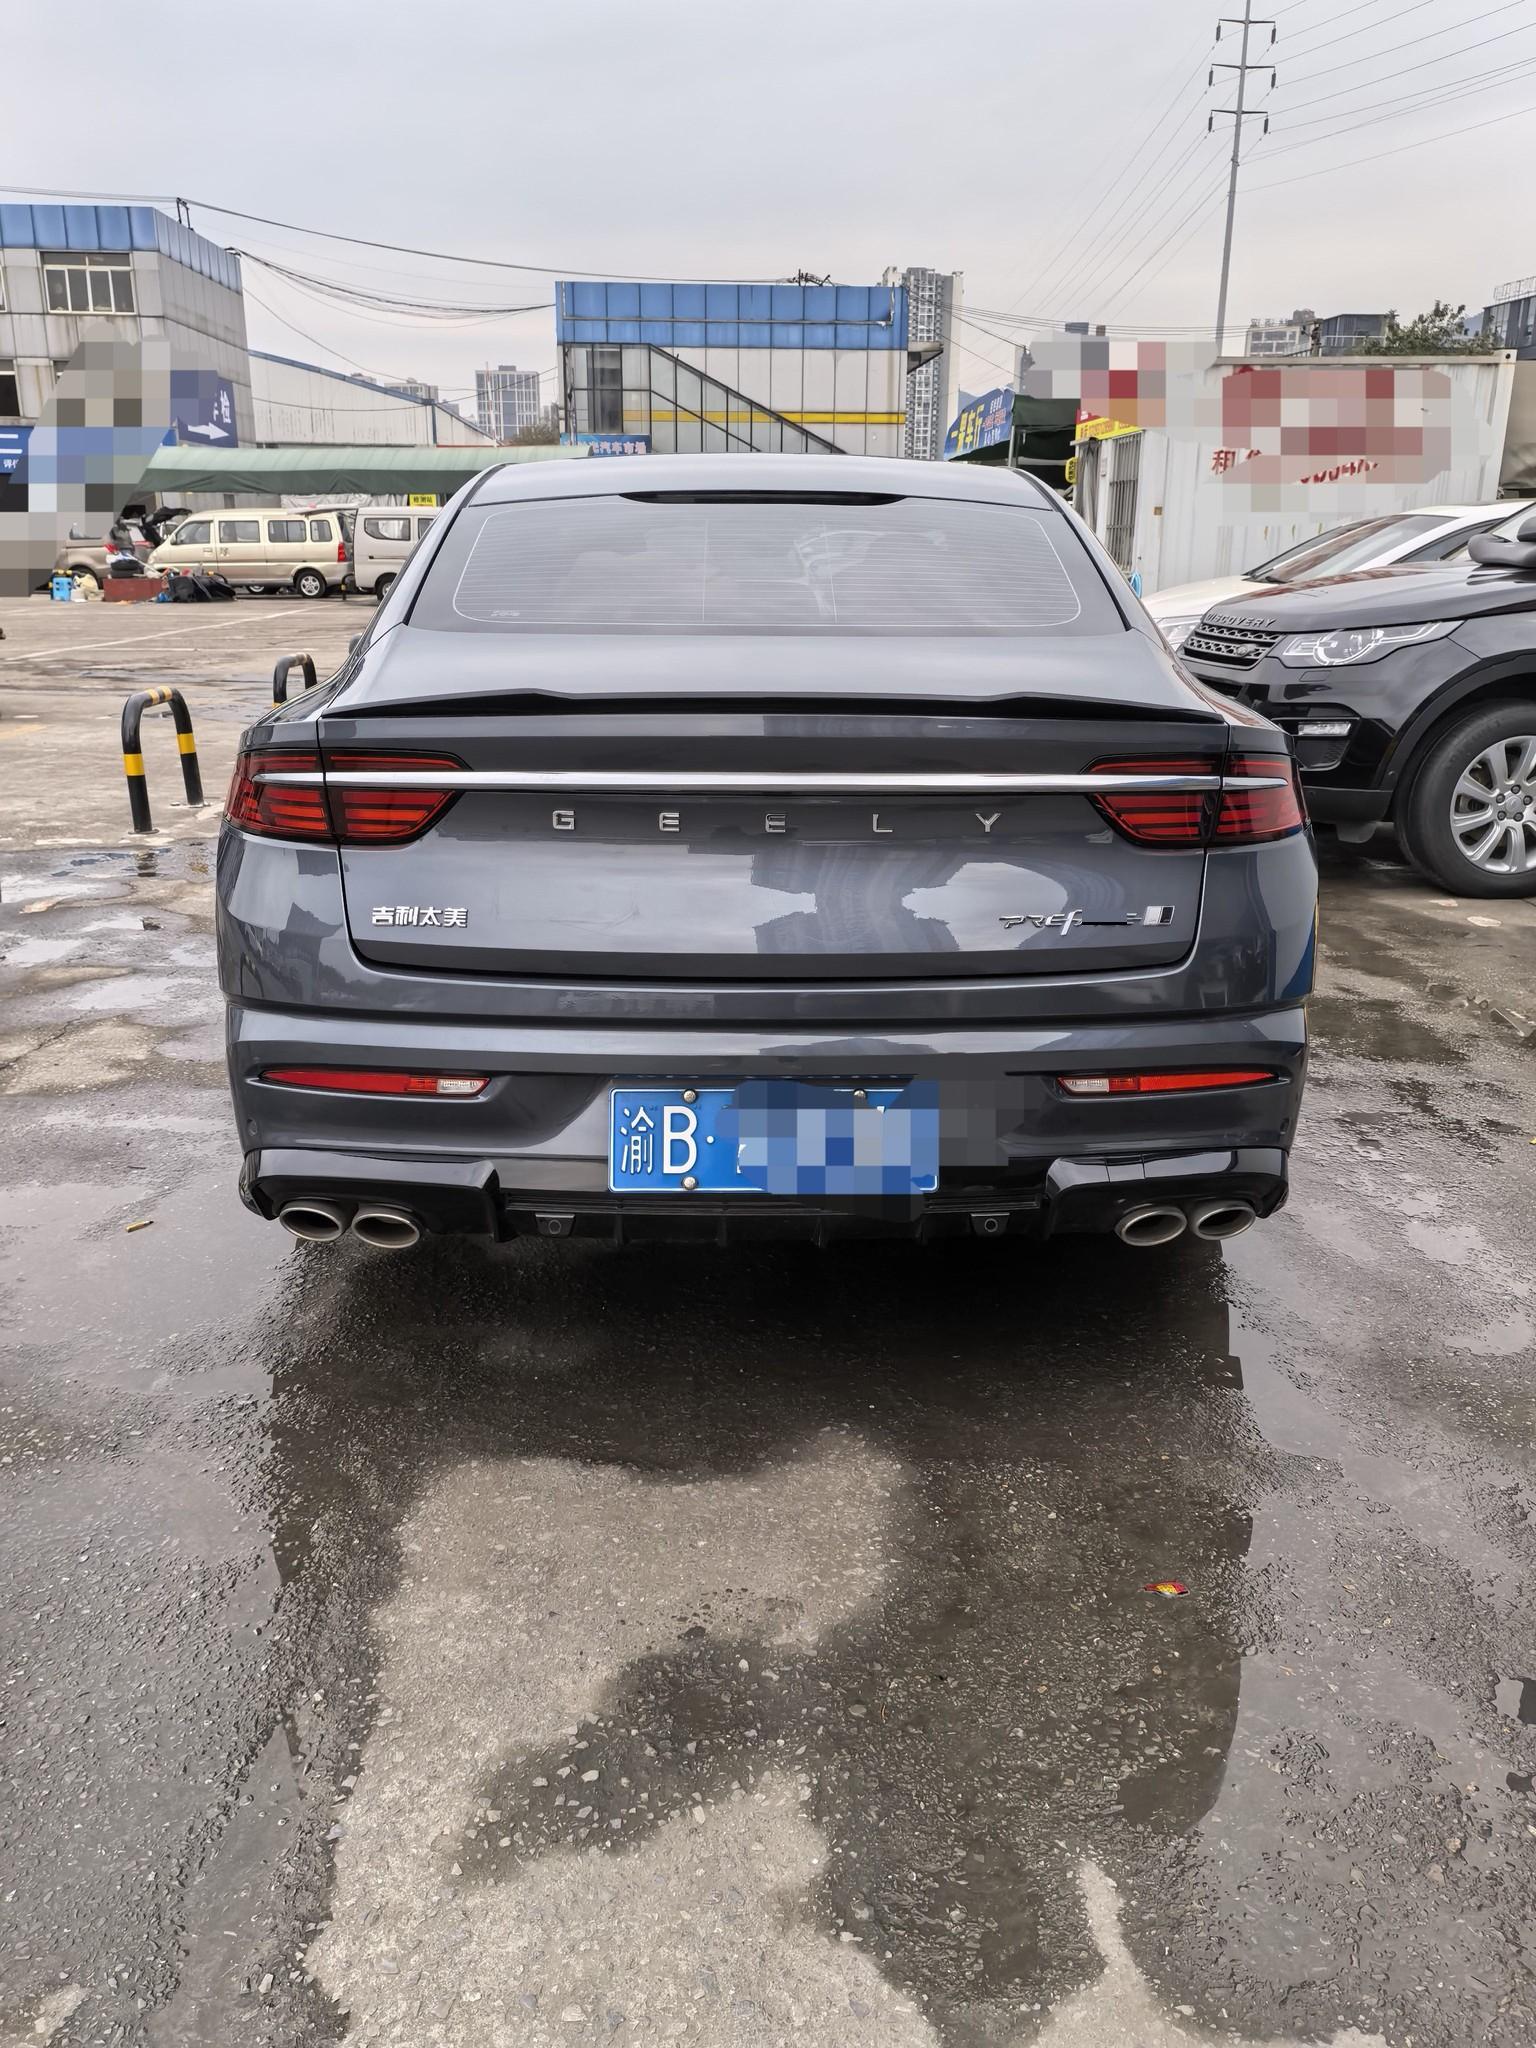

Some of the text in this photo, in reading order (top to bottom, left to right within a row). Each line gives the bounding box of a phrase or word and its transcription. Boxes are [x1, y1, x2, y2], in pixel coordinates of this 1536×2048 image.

[1205, 613, 1276, 628] DISCOVERY
[552, 809, 1001, 833] GEELY
[371, 905, 468, 928] 吉利太美
